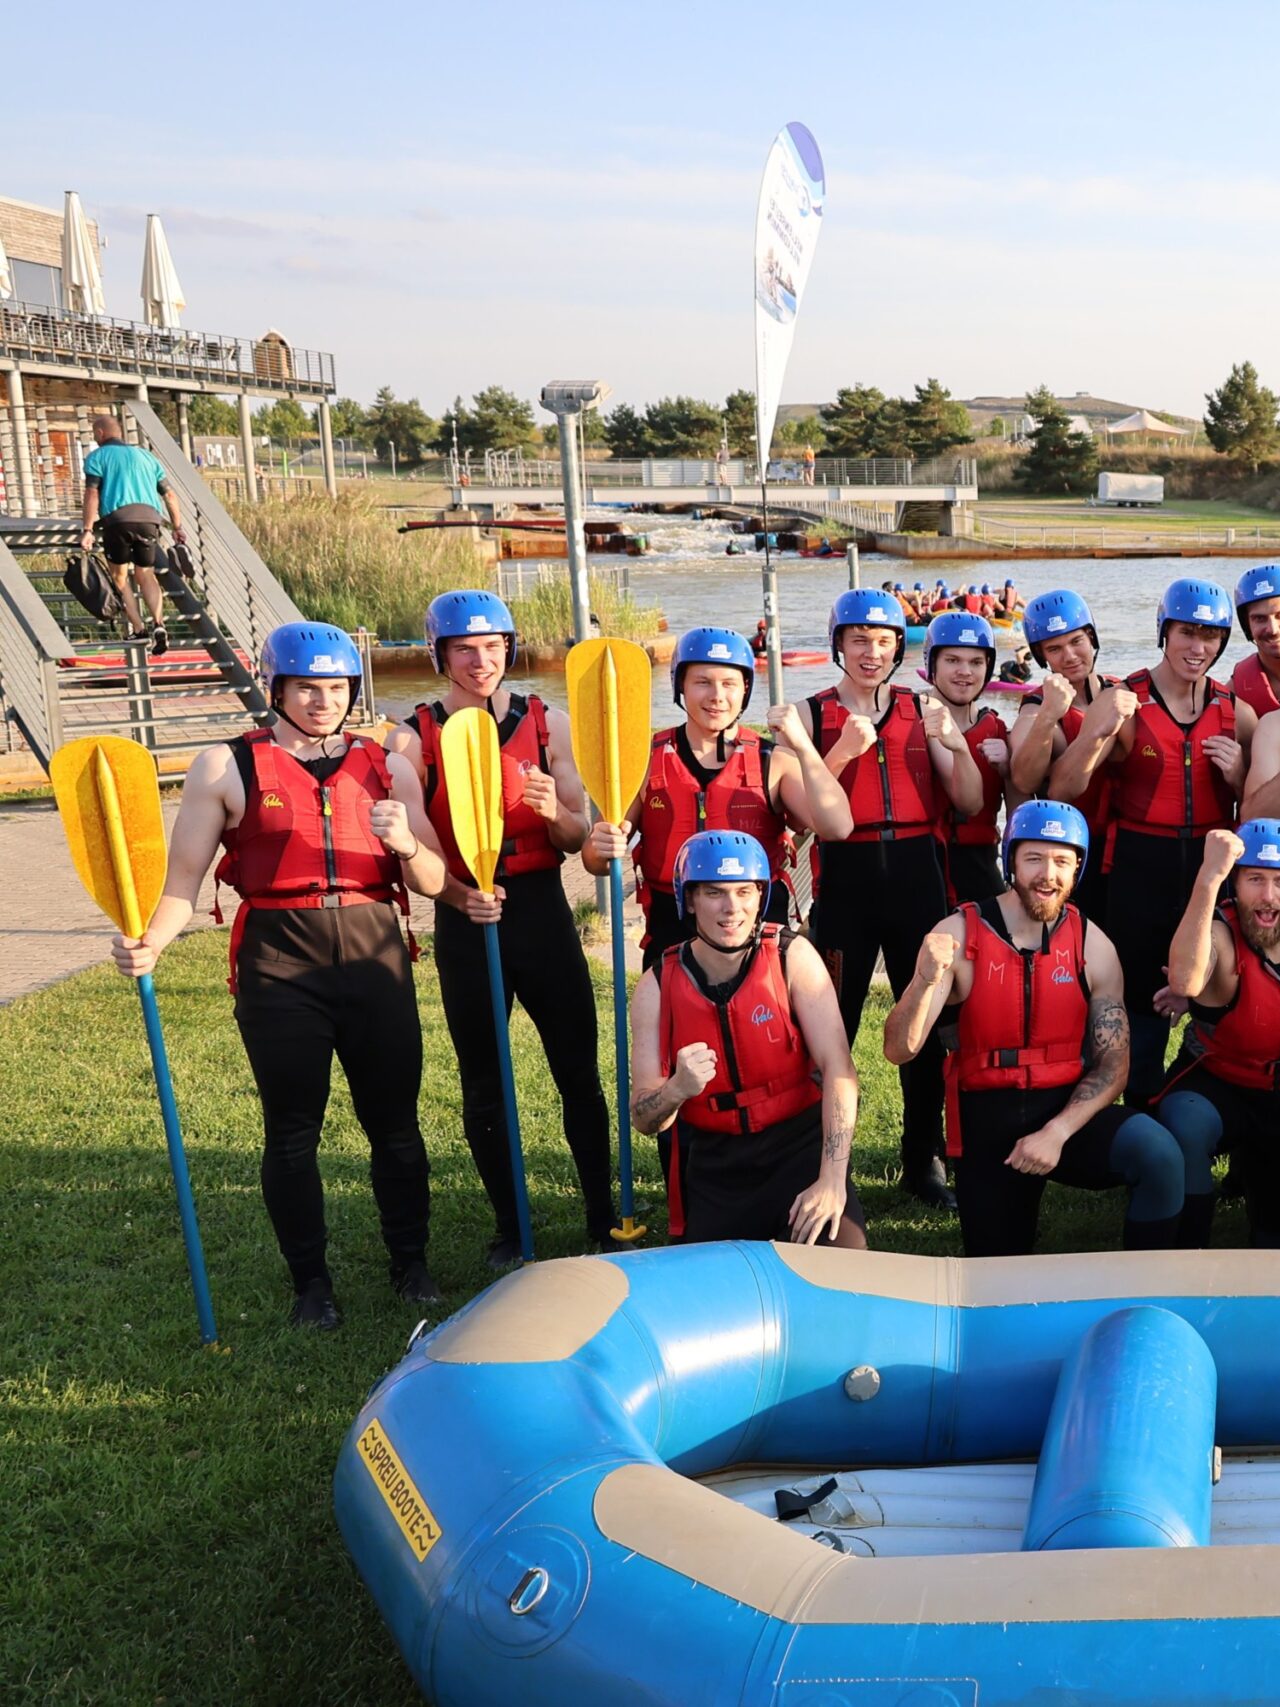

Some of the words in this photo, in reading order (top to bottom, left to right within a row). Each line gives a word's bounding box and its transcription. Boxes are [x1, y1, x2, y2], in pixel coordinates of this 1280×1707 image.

[764, 592, 776, 616] 3
[766, 627, 777, 651] 4
[263, 793, 284, 809] Palm
[1055, 949, 1070, 965] M
[987, 960, 1006, 985] M
[1051, 965, 1074, 985] Palm
[766, 1026, 781, 1044] L
[369, 1441, 400, 1490] SPREU
[389, 1479, 425, 1535] BOOTE
